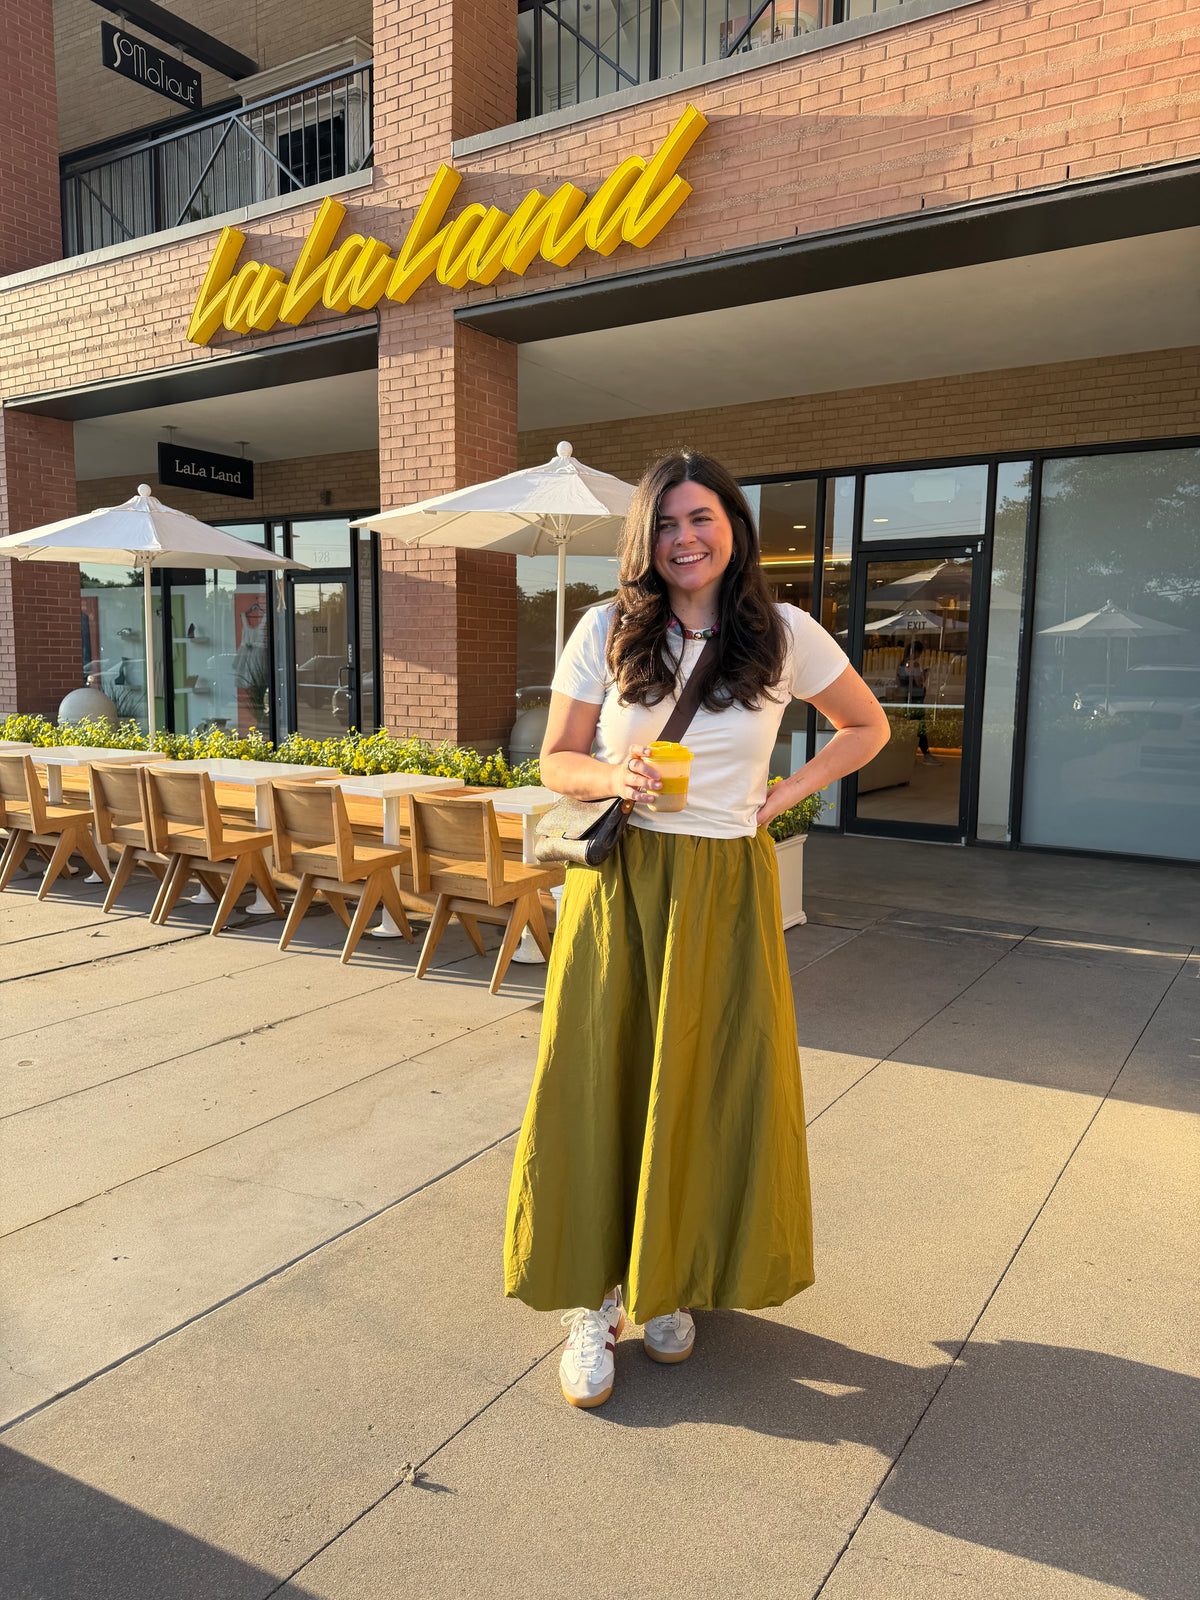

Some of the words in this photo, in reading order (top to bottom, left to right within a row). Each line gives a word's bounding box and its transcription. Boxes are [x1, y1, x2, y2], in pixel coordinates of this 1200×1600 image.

[175, 459, 207, 478] LaLa
[211, 466, 242, 485] Land
[313, 550, 330, 563] 128
[312, 625, 328, 633] ENTER
[907, 621, 927, 630] EXIT
